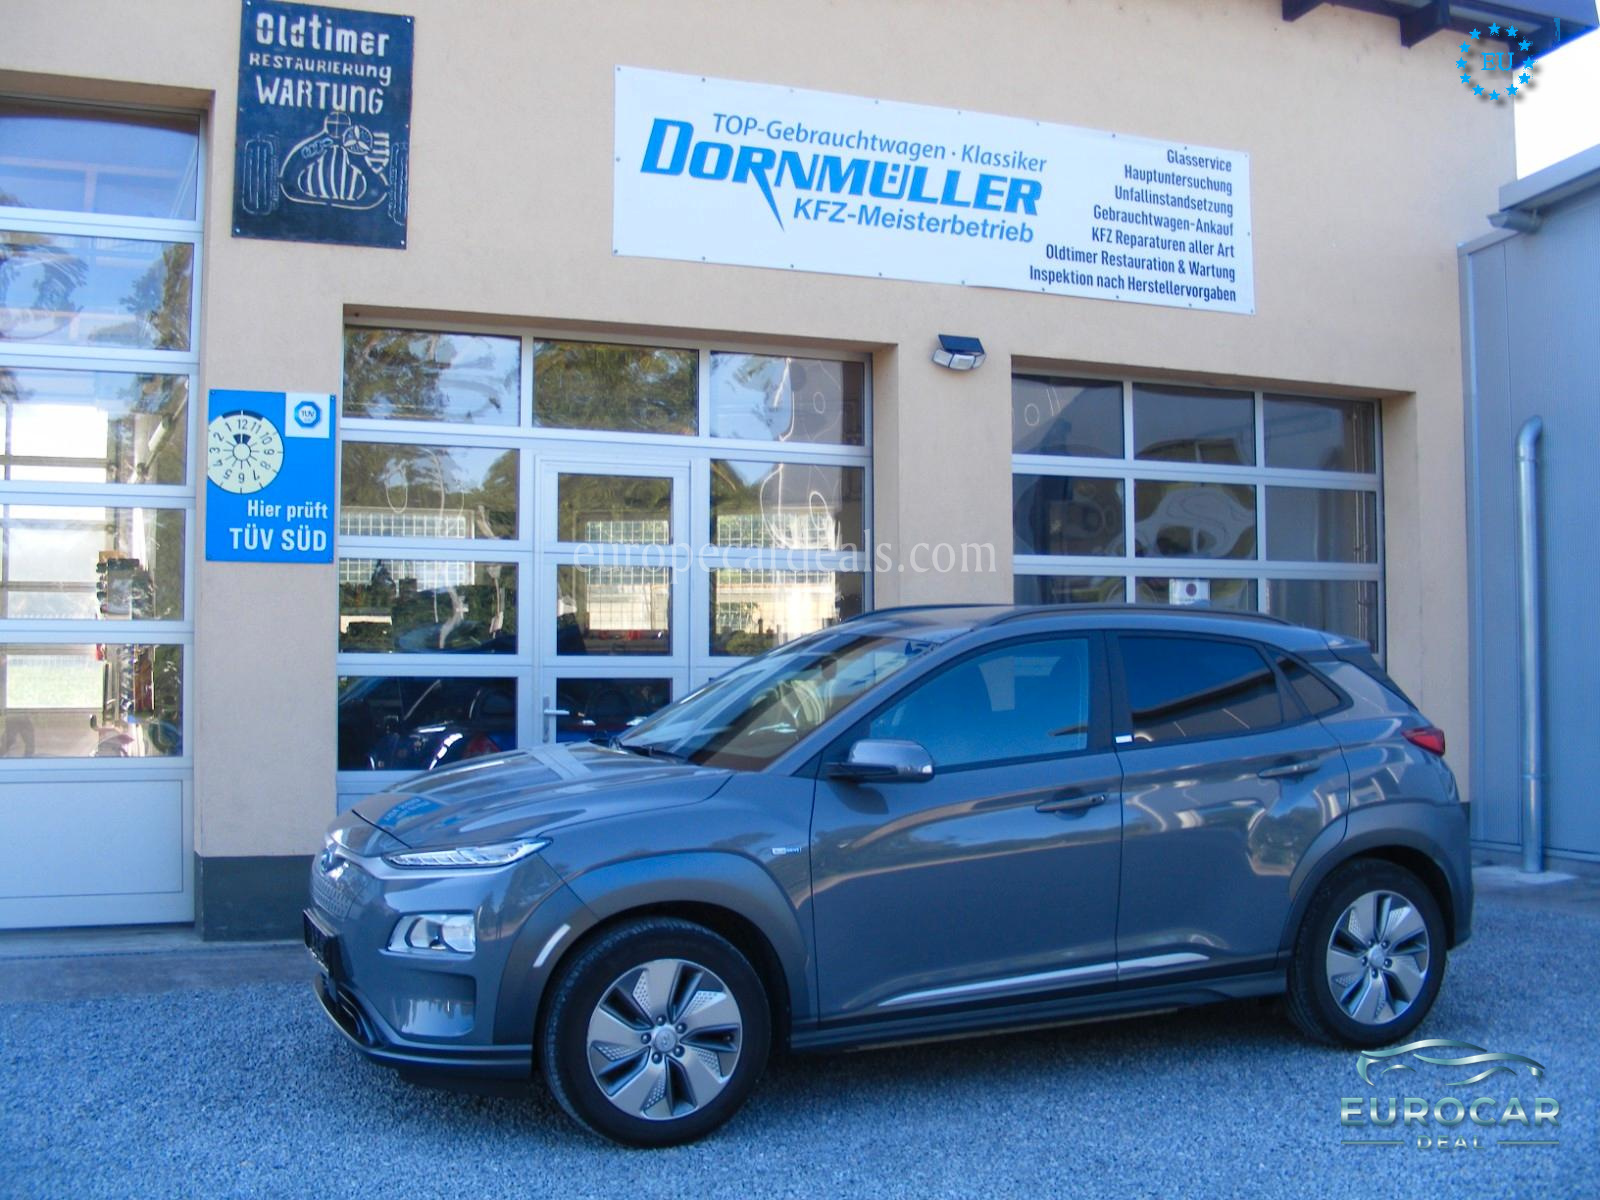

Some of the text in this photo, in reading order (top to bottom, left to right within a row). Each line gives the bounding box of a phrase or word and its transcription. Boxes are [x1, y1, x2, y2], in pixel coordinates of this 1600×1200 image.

[256, 13, 390, 56] Oldtimer
[713, 112, 1047, 173] TOP-Gebrauchtwagen Klassiker
[1167, 149, 1232, 172] Glasservice
[1124, 164, 1233, 196] Hauptuntersuchung
[1114, 185, 1234, 218] Unfallinstandsetzung
[793, 197, 1034, 243] KFZ-Meisterbetrieb
[1093, 204, 1234, 237] Gebrauchtwagen-Ankauf
[1091, 226, 1235, 259] KFZ Reparaturen aller Art
[1045, 244, 1236, 284] Oldtimer Restauration & Wartung
[1029, 265, 1237, 303] Inspektion nach Herstellervorgaben
[212, 431, 224, 442] 2
[238, 418, 248, 430] 12
[209, 446, 221, 454] 3
[260, 460, 271, 470] 8
[248, 500, 328, 522] Hier prüft
[229, 523, 327, 551] TÜV SÜD
